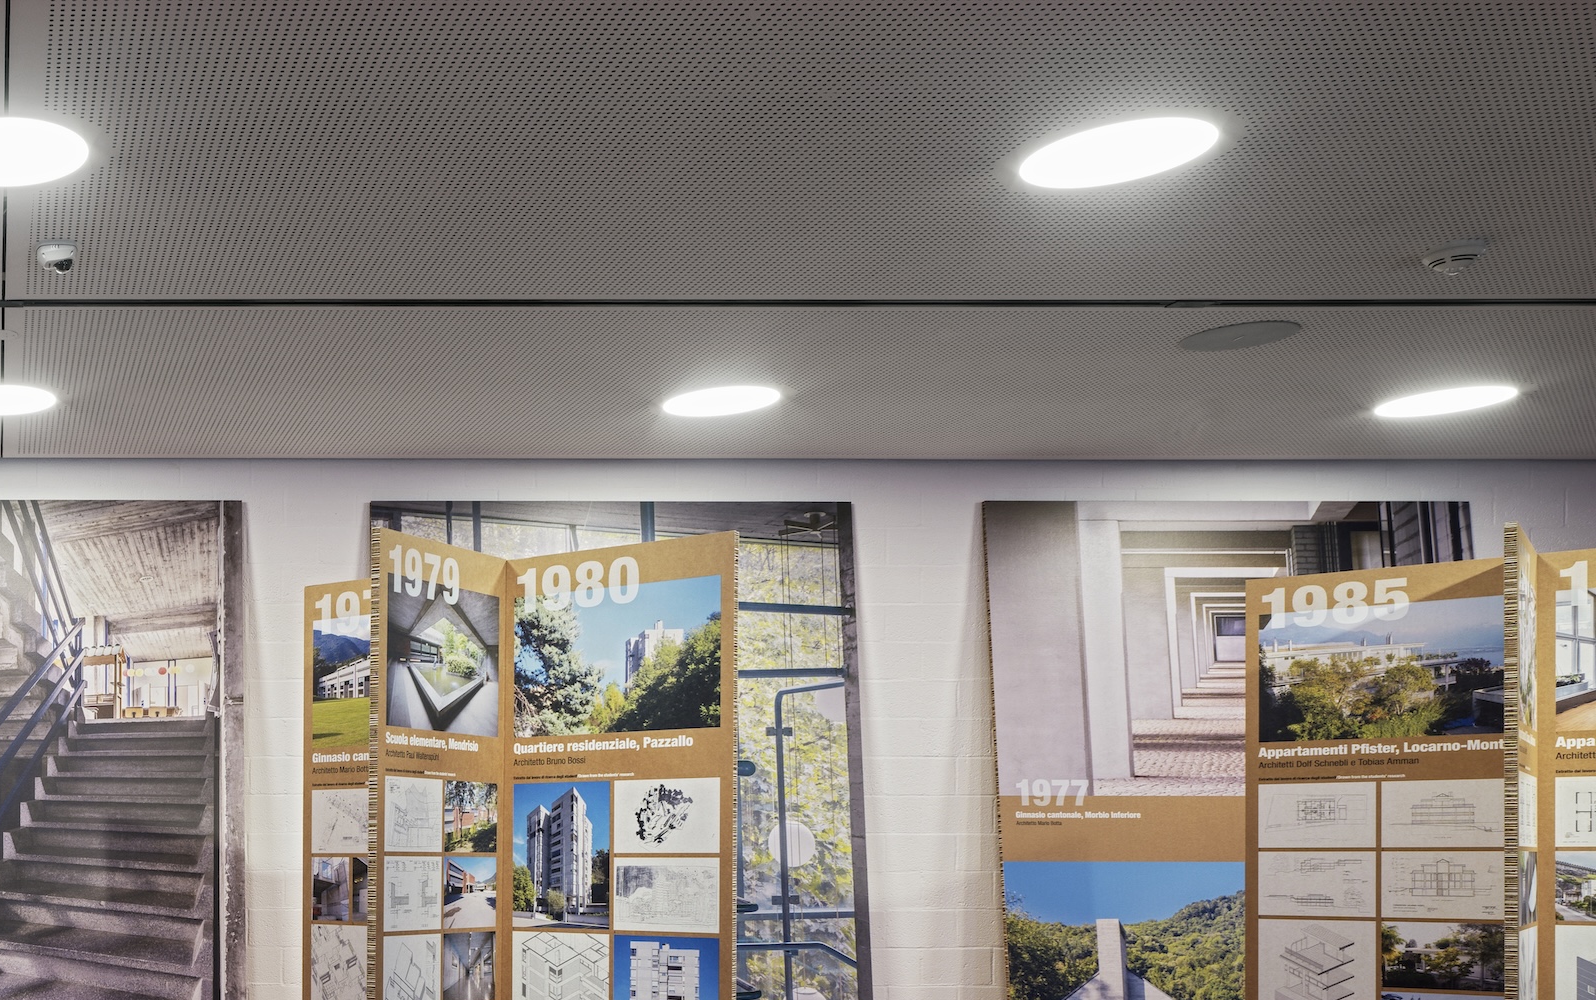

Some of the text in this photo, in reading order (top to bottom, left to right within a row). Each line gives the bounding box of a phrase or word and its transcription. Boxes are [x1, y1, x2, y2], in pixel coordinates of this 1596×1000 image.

[389, 544, 460, 605] 1979
[516, 556, 640, 613] 1980
[1559, 560, 1588, 606] 1
[1261, 577, 1410, 629] 1985
[385, 731, 479, 752] Scuola elementare, Mendrisio
[513, 735, 694, 755] Quartiere residenziale, Pazzallo
[1258, 739, 1504, 760] Appartamenti Pfister, Locarno-Mont
[1555, 736, 1596, 750] Appa
[312, 751, 370, 763] Ginnasio can
[513, 756, 586, 766] Architetto Bruno Bossi
[1258, 761, 1294, 769] Architetti
[1296, 760, 1312, 768] Dolf
[1314, 759, 1348, 768] Schnebli
[1358, 758, 1384, 766] Tobias
[1386, 757, 1420, 765] Amman
[1555, 752, 1596, 760] Architett
[312, 765, 369, 775] Architetto Mario Bott
[1015, 778, 1089, 807] 1977
[1015, 811, 1141, 820] Ginnasio cantonale, Morbio Inferiore
